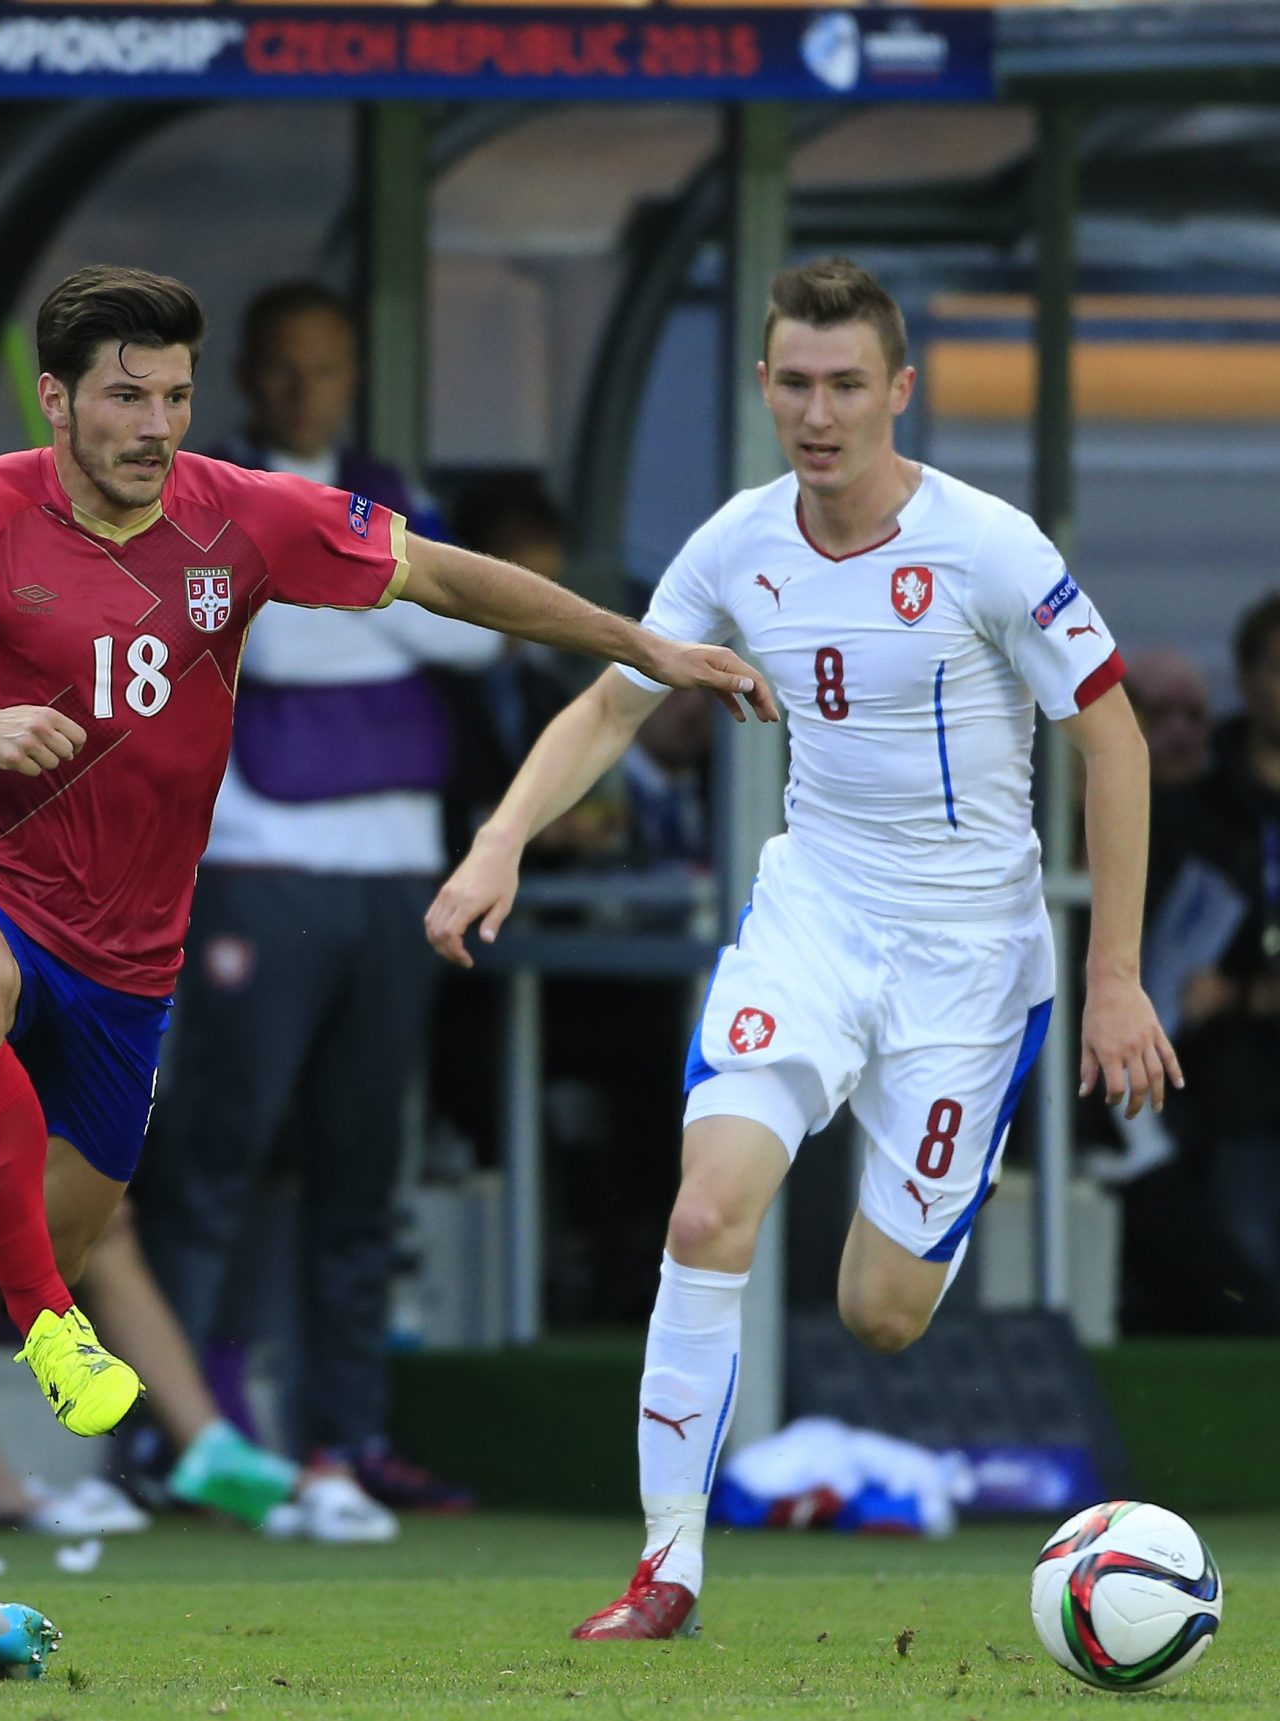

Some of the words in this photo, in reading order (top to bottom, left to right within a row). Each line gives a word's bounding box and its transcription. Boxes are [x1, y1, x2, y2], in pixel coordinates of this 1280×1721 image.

[244, 20, 398, 75] CZECH
[406, 22, 630, 77] REPUBLIC
[639, 23, 760, 78] 2015
[92, 632, 172, 720] 18
[813, 646, 850, 721] 8
[915, 1097, 963, 1180] 8
